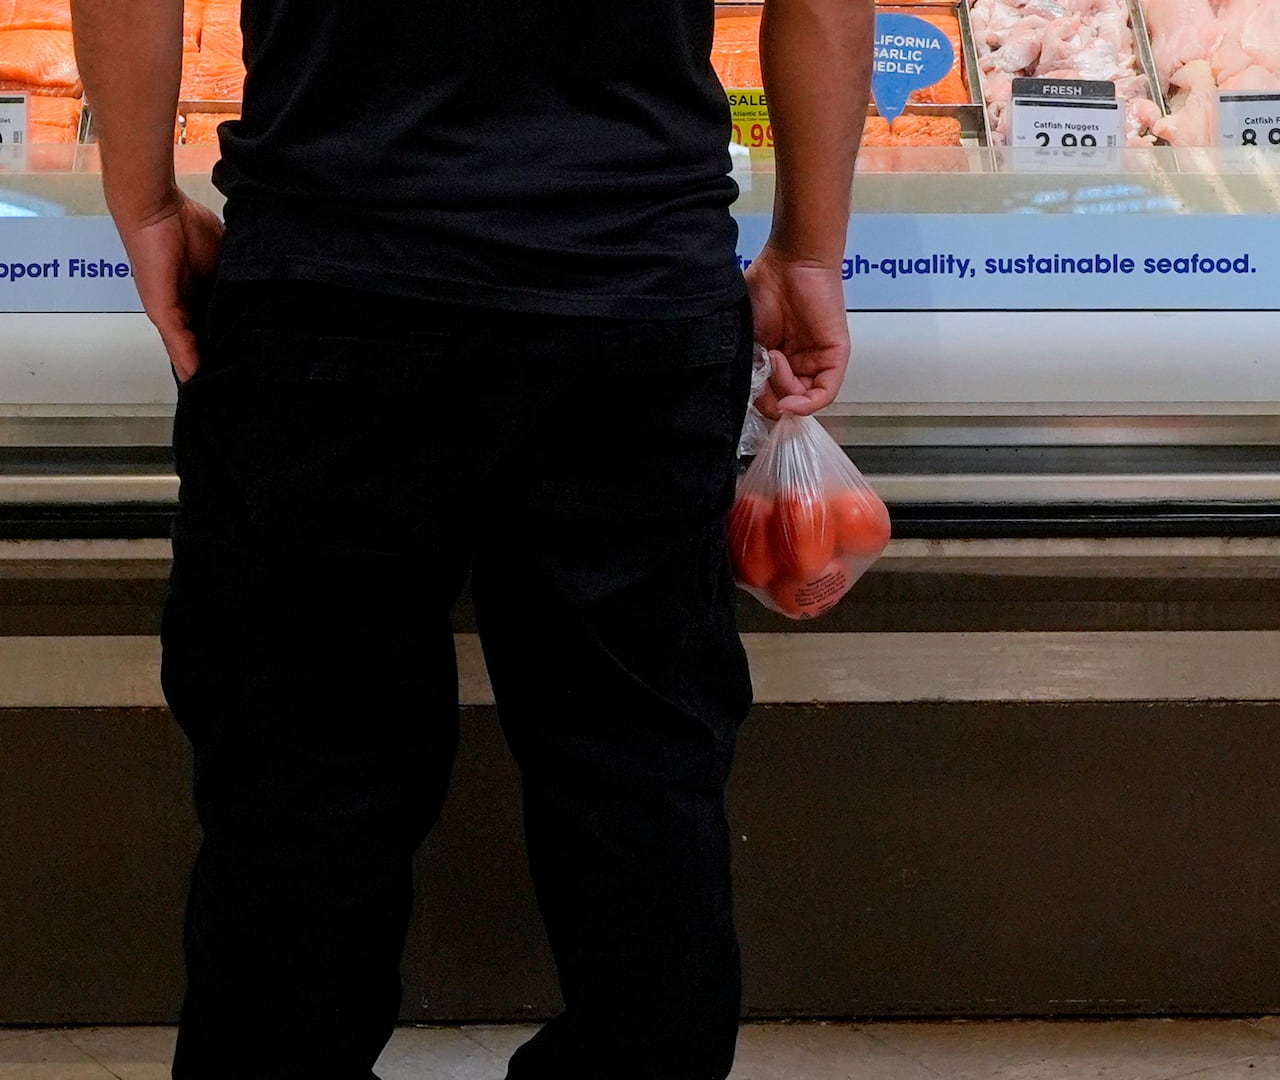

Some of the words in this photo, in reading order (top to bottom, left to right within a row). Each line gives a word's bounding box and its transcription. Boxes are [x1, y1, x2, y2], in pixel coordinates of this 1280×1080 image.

[1042, 85, 1083, 96] FRESH
[729, 94, 767, 106] SALE
[1033, 121, 1063, 129] Catfish
[1064, 122, 1100, 131] Nuggets
[1244, 116, 1274, 125] Catfish
[68, 258, 134, 278] Fishe
[984, 254, 1135, 274] sustainable
[1143, 254, 1257, 274] seafood.
